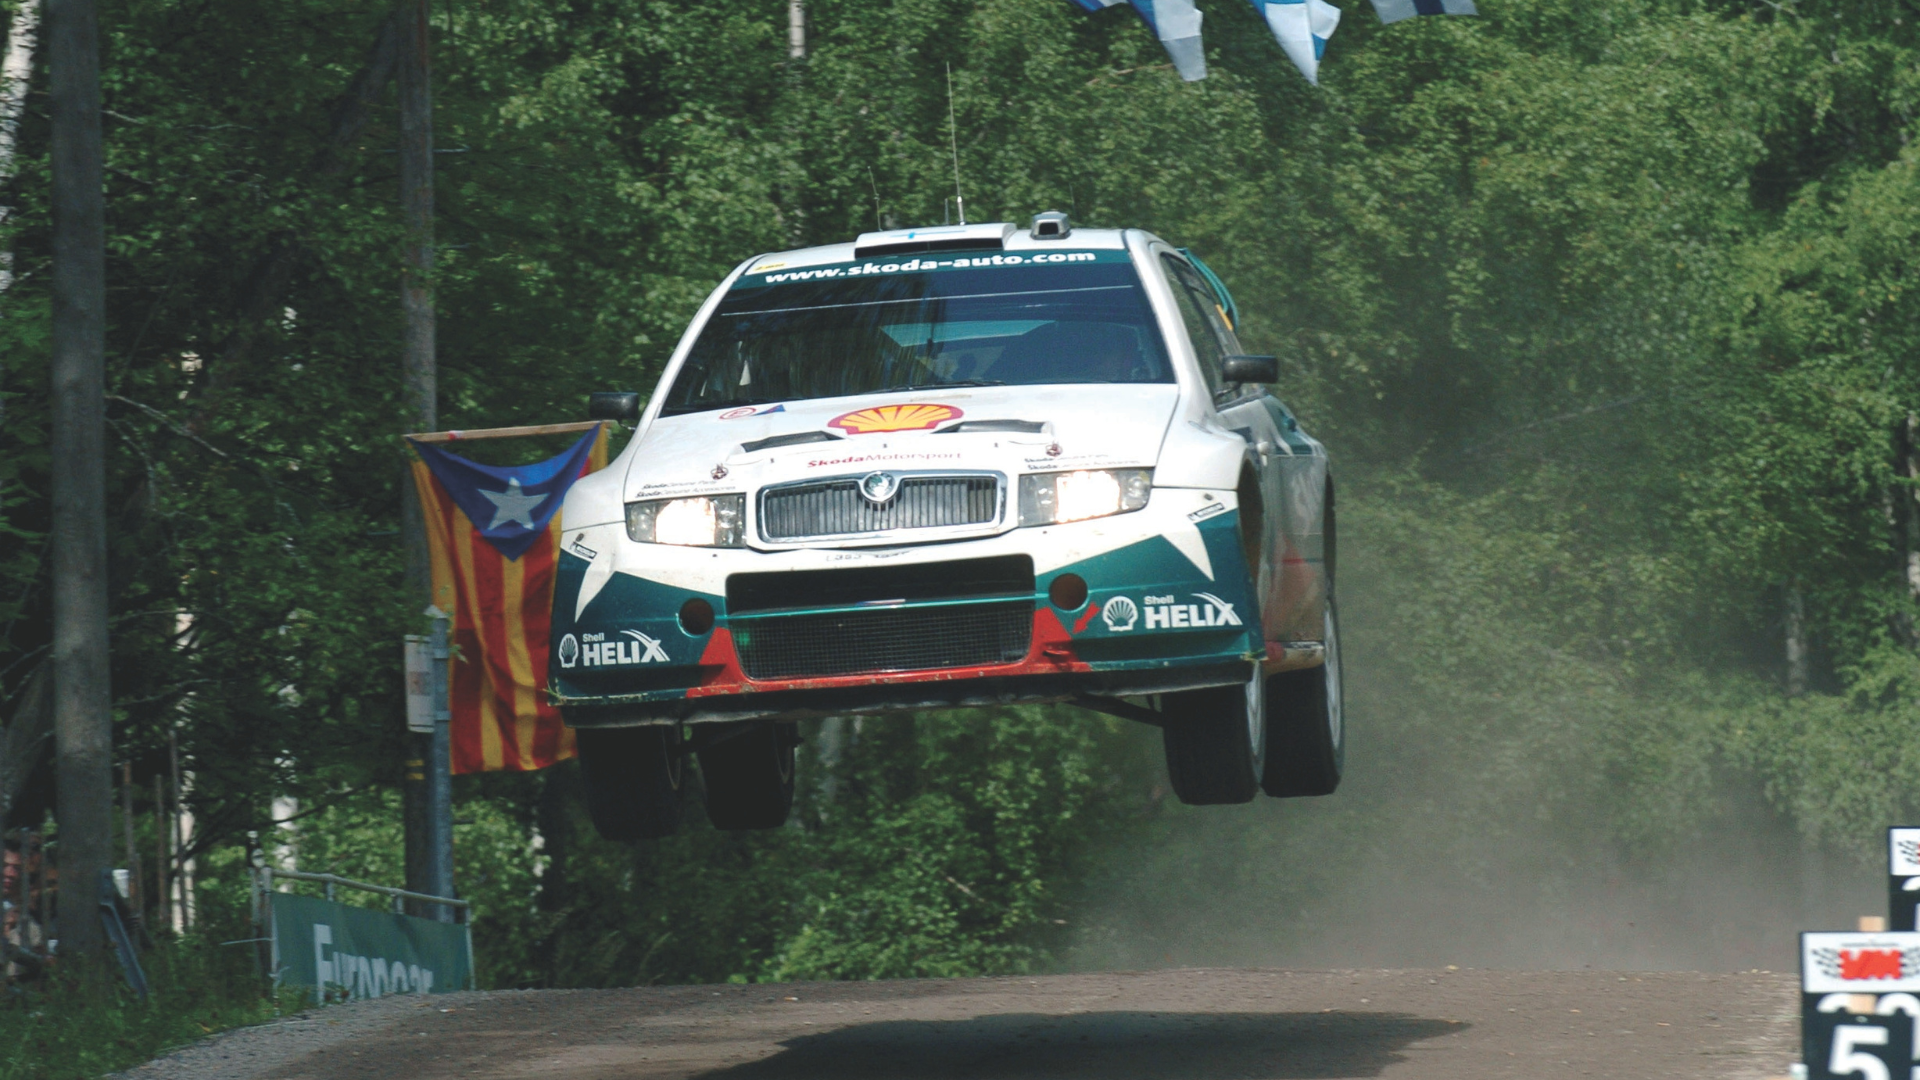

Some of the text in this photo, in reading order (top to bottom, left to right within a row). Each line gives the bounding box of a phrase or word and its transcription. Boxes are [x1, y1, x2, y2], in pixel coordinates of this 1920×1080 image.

[764, 252, 1096, 283] www.skoda-auto.com
[1143, 595, 1175, 604] Shell
[1143, 592, 1243, 629] HELIX
[582, 633, 605, 642] Shell
[582, 629, 671, 666] HELIX
